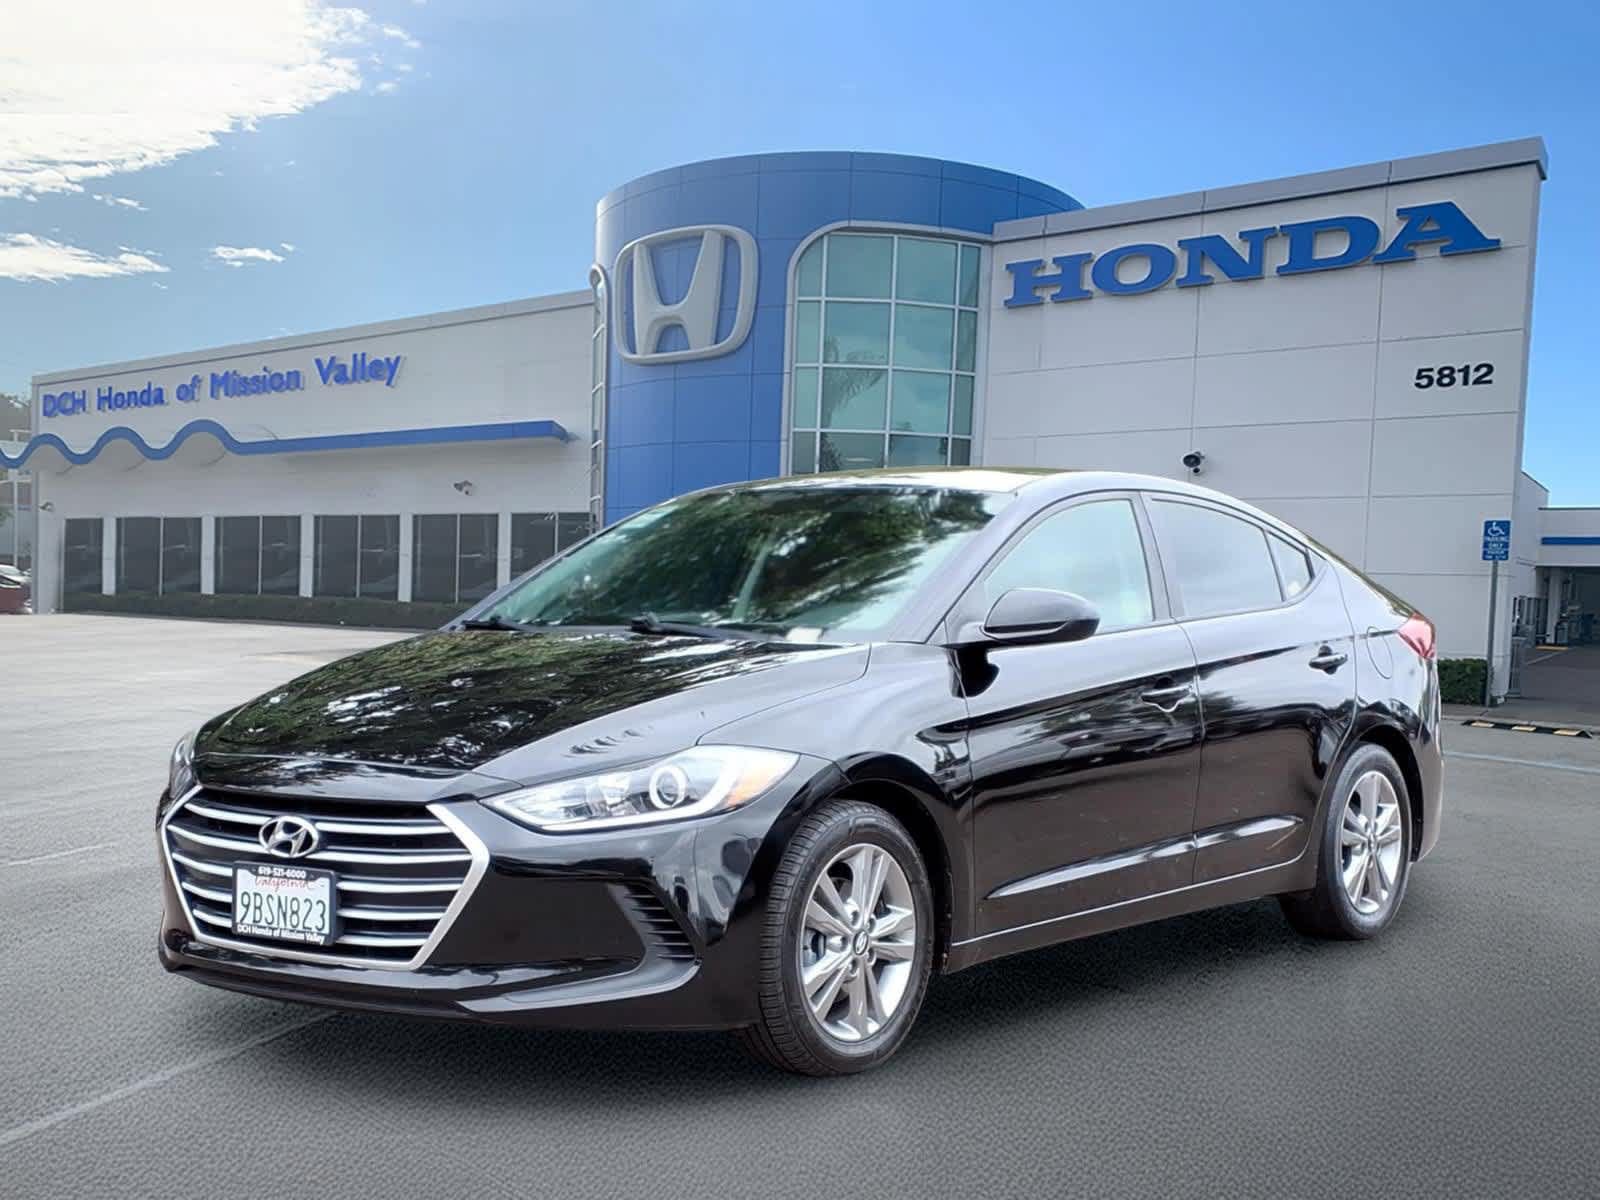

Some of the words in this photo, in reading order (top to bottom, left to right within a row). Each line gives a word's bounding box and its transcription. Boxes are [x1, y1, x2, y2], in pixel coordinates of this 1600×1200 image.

[1003, 200, 1502, 309] HONDA
[42, 391, 86, 418] DCH
[97, 382, 165, 412] Honda
[176, 375, 201, 402] of
[210, 367, 304, 400] Mission
[314, 352, 402, 389] Valley
[1414, 363, 1494, 389] 5812
[240, 891, 326, 932] 9BSN823
